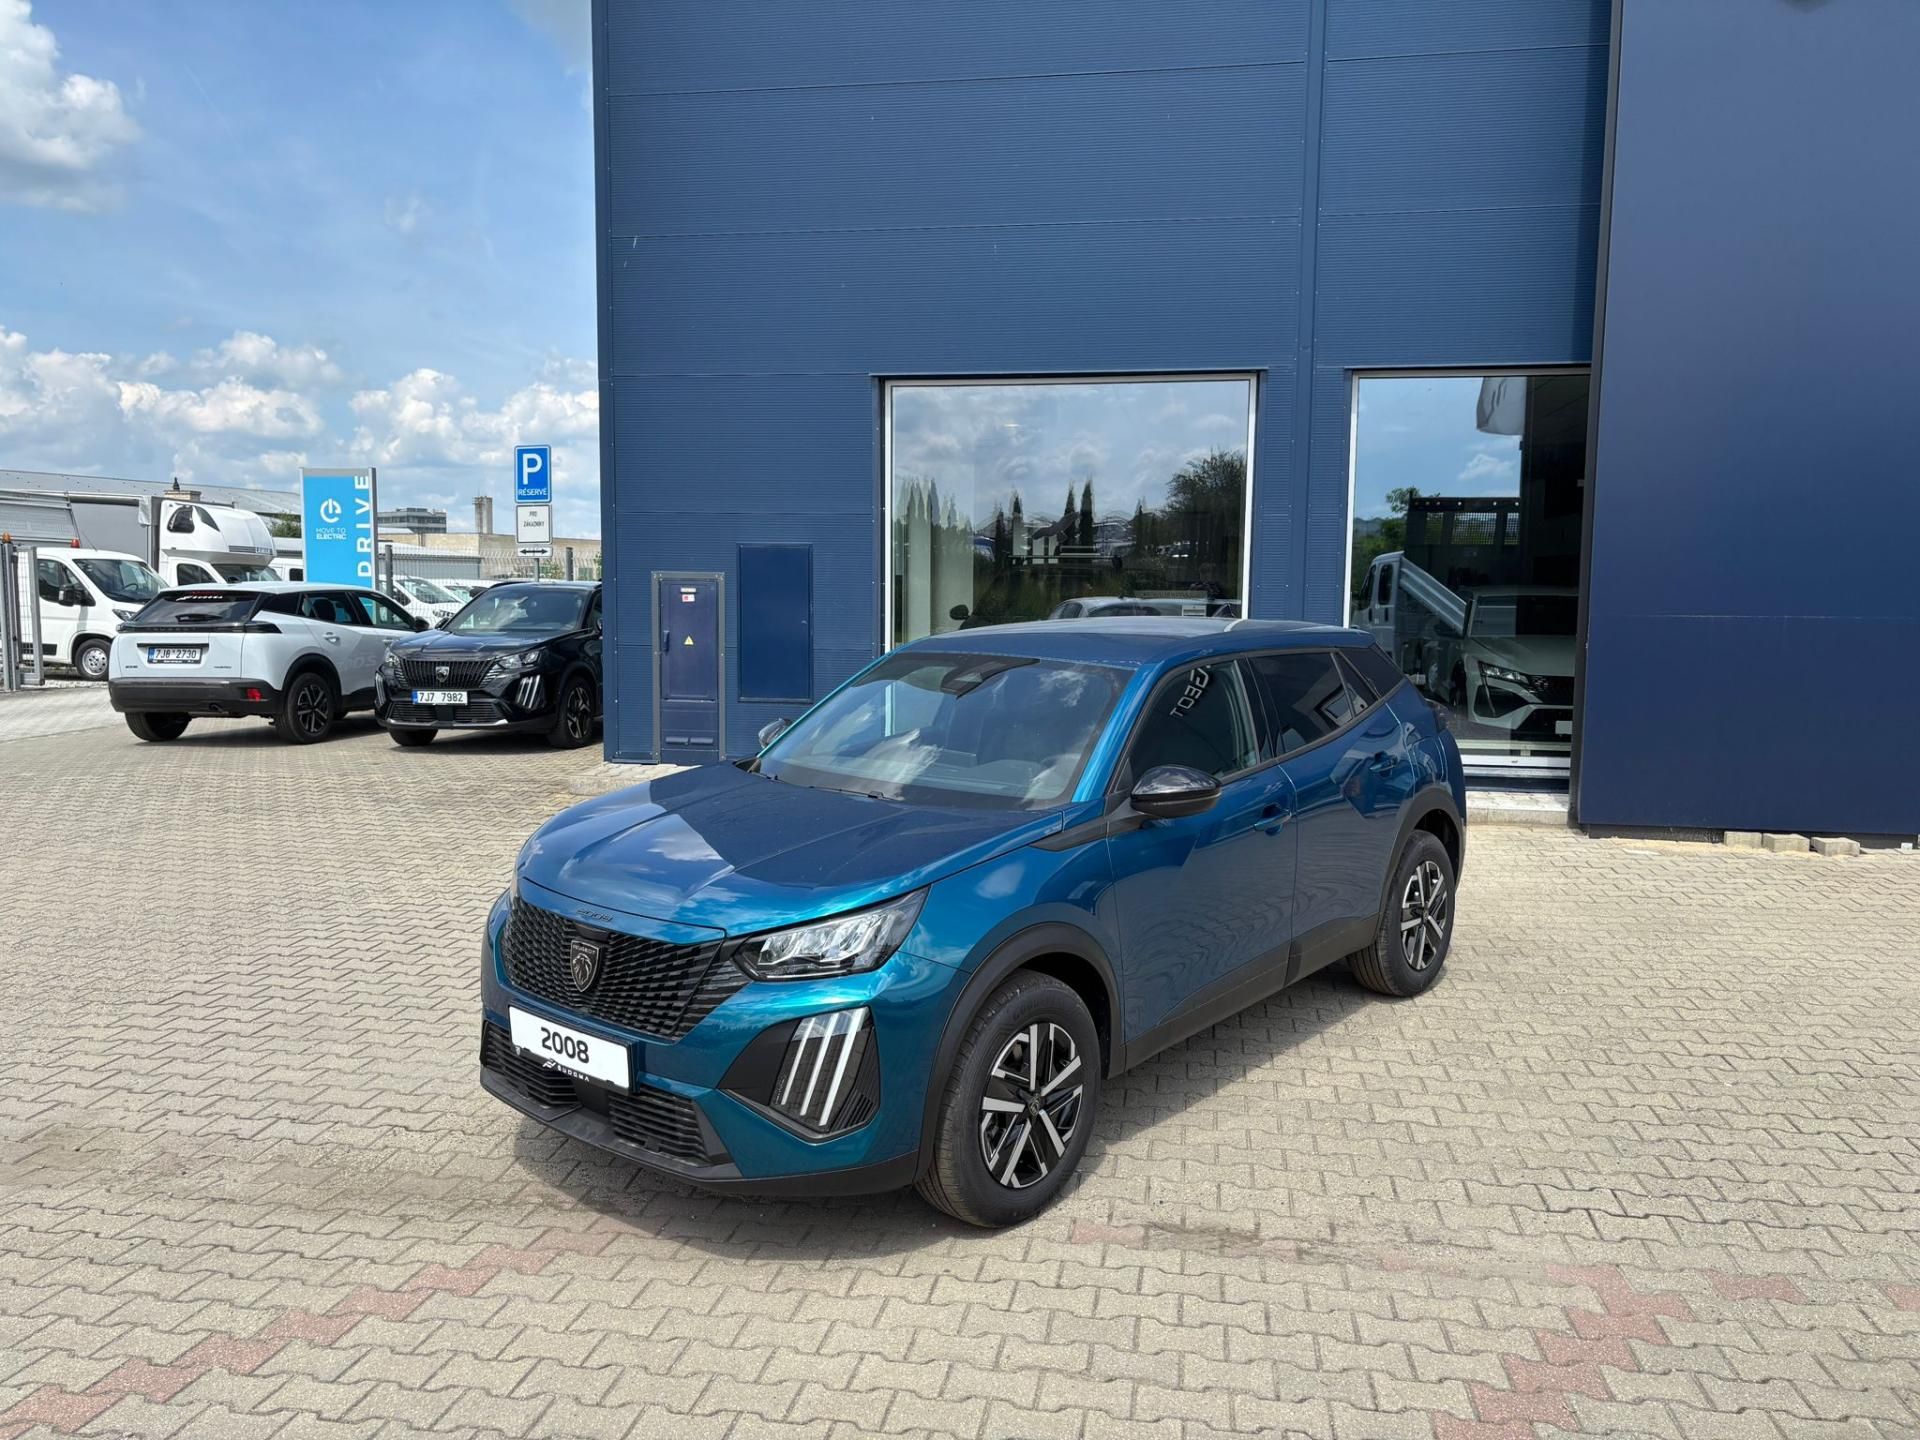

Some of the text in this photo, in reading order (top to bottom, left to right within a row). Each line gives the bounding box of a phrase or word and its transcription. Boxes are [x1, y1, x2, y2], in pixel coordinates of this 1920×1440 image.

[523, 453, 542, 485] P
[354, 475, 371, 577] DRIVE
[419, 693, 463, 702] 7J7 7982
[541, 1027, 589, 1063] 2008
